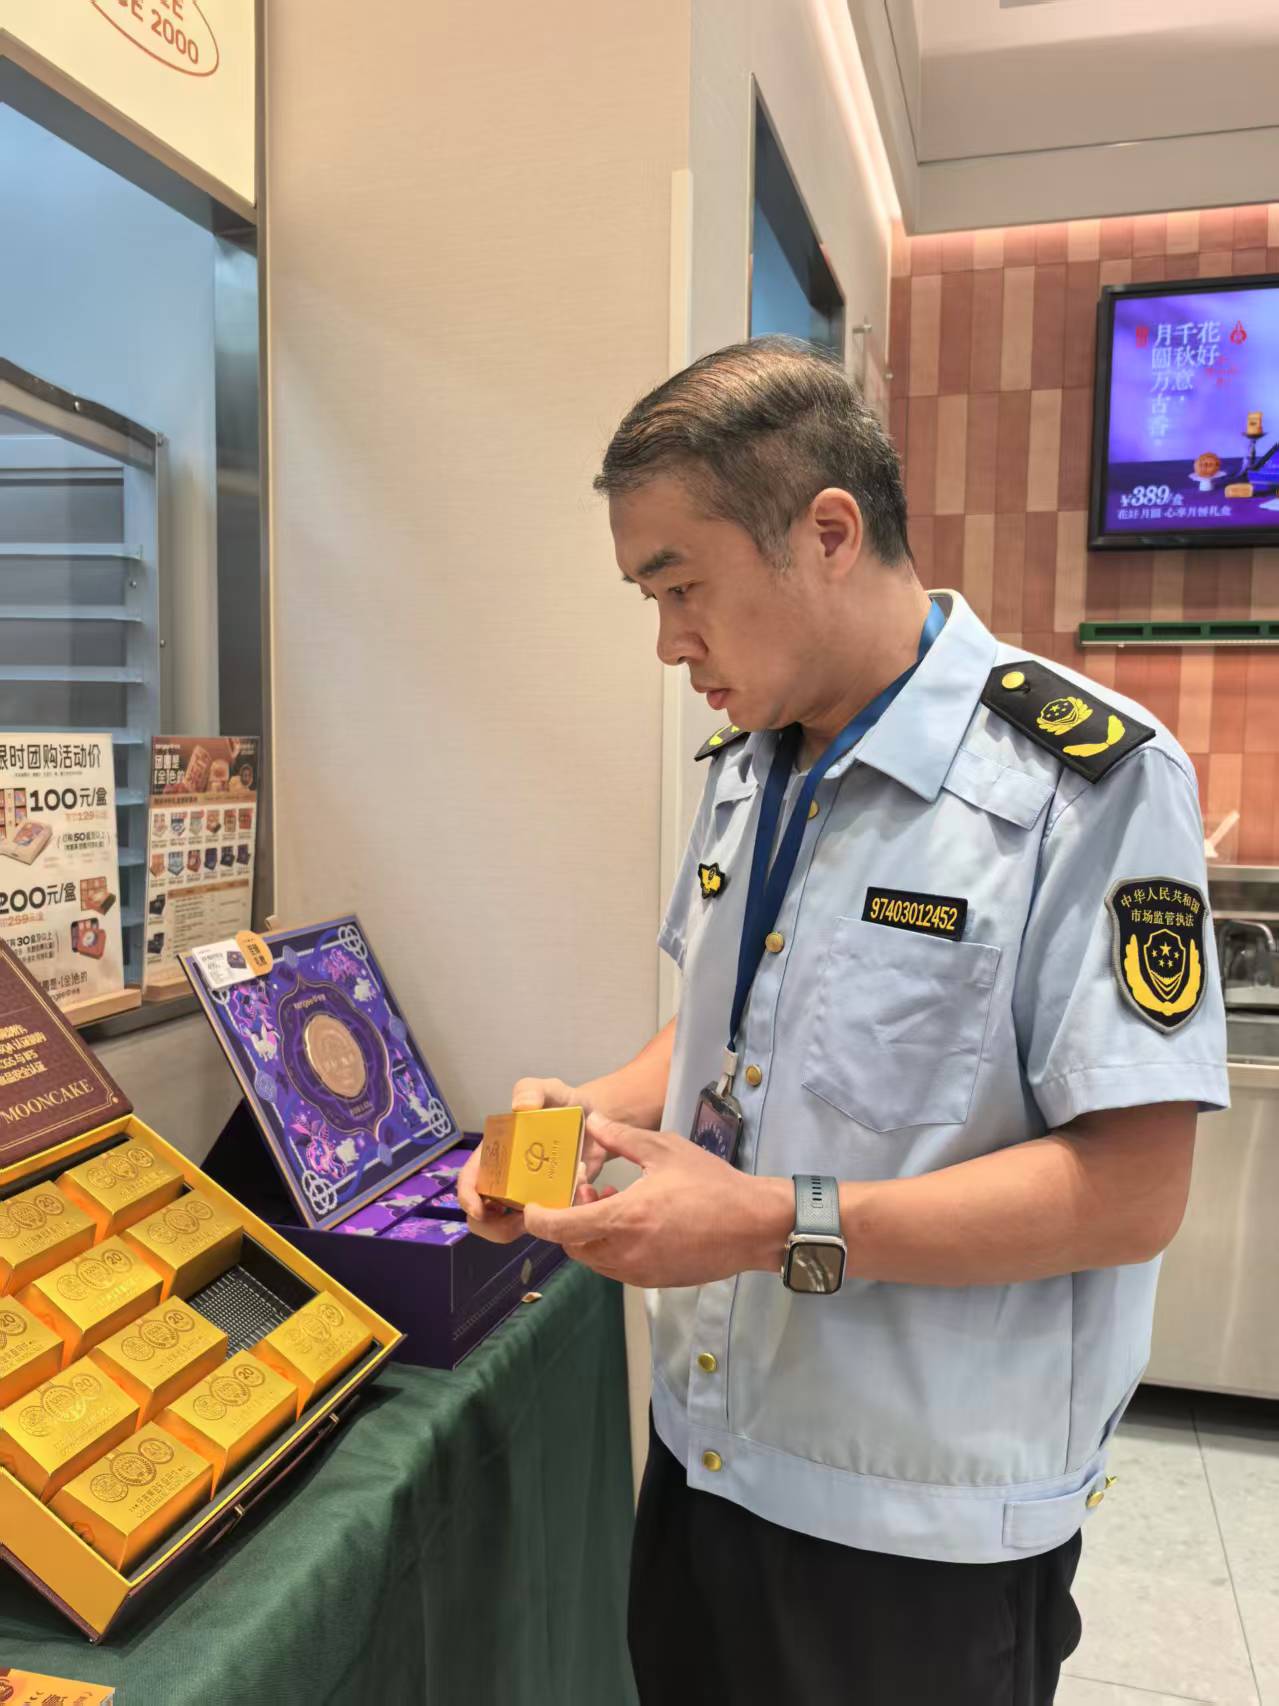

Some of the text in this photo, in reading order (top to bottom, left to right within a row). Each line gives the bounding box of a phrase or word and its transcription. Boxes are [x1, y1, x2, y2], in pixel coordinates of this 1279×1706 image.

[151, 9, 198, 64] 2000
[29, 787, 107, 812] 100元/盒
[0, 882, 77, 914] 200元/盒
[1121, 886, 1201, 914] 中华人民共和国
[870, 897, 957, 931] 97403012452
[1131, 908, 1195, 927] 市场监管执法
[0, 1079, 95, 1124] MOONCAKE
[106, 1252, 122, 1265] 20
[168, 1312, 184, 1325] 20
[238, 1366, 253, 1380] 20
